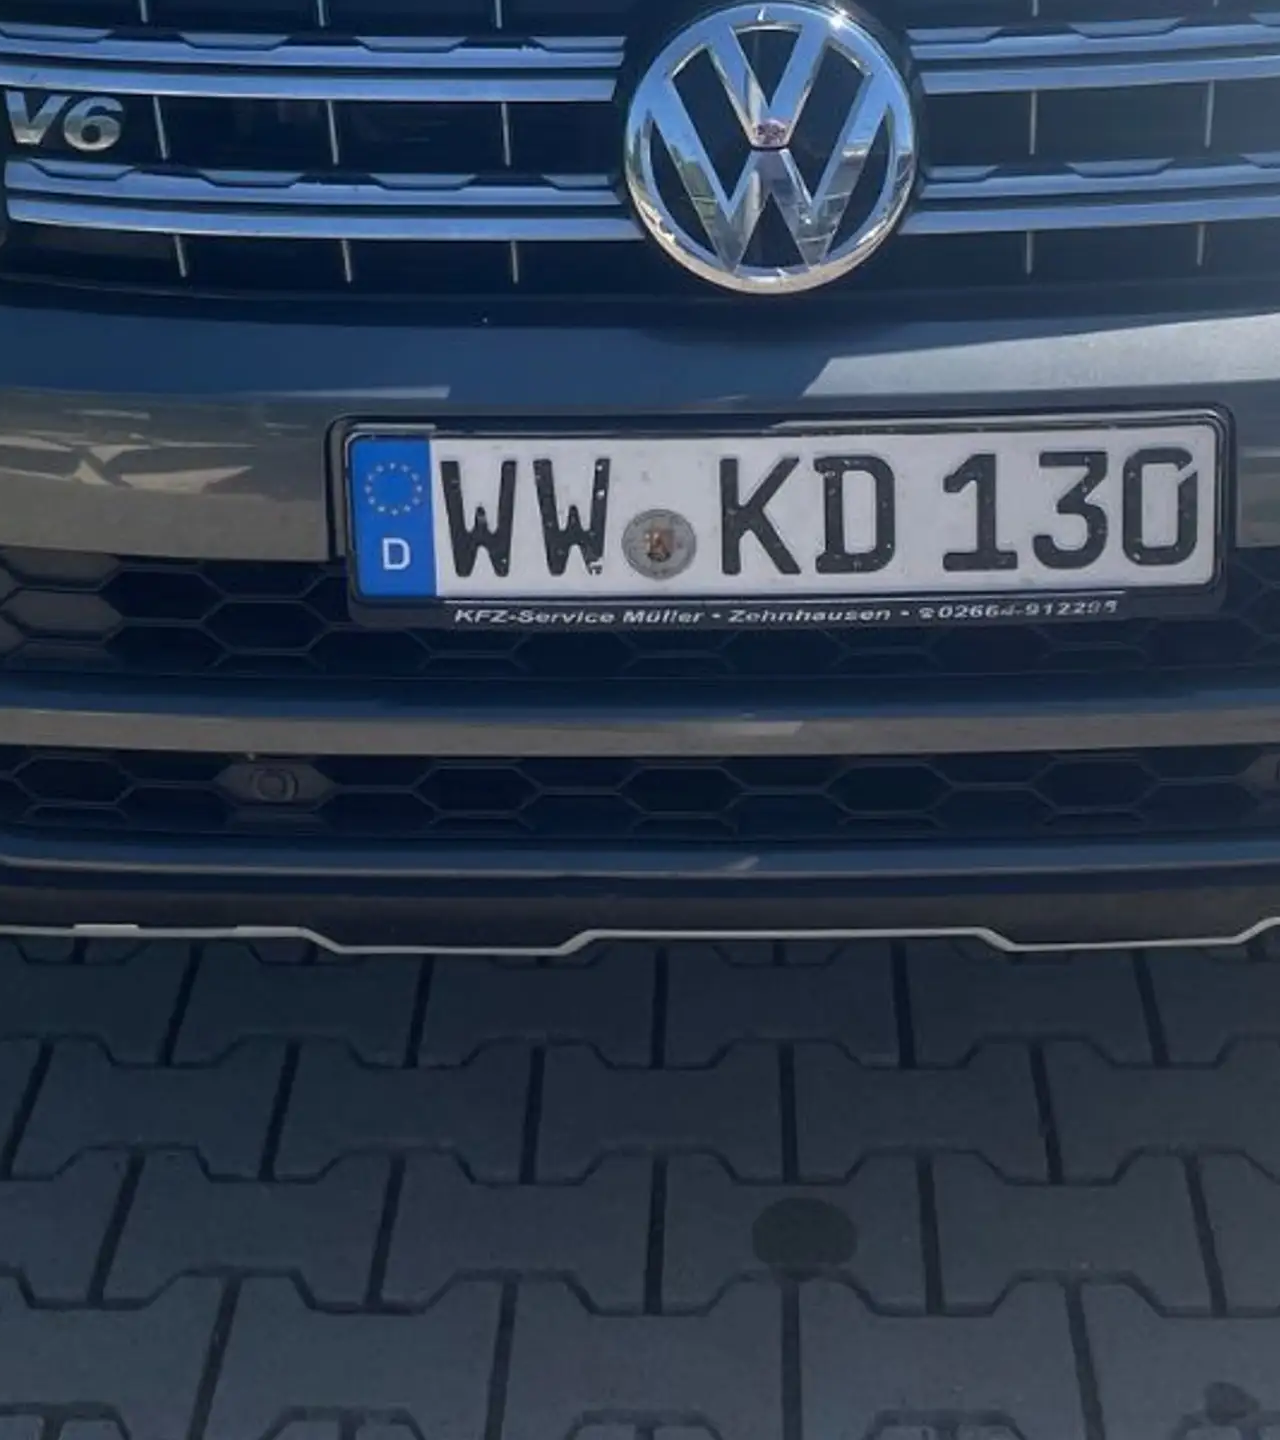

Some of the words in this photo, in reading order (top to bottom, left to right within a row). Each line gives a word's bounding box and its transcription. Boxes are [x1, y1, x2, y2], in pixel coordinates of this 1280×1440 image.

[5, 90, 123, 152] V6
[440, 458, 611, 577] WW
[719, 453, 896, 576] KD
[942, 447, 1199, 571] 130
[382, 537, 412, 570] D
[454, 608, 615, 624] KFZ-Service
[622, 607, 706, 624] Müller
[728, 606, 891, 624] Zehnhausen
